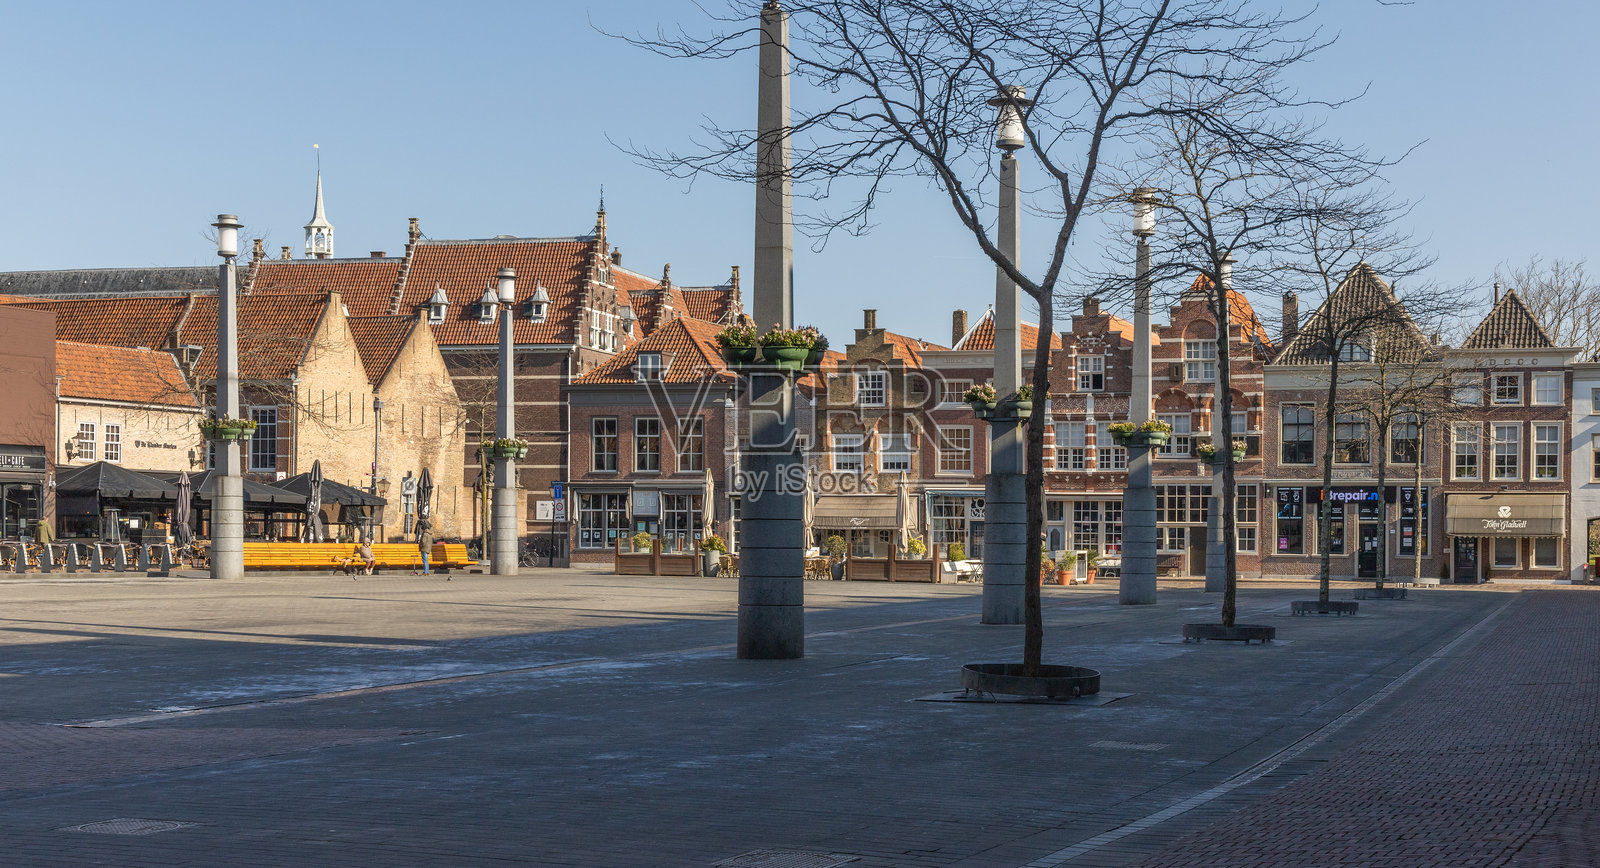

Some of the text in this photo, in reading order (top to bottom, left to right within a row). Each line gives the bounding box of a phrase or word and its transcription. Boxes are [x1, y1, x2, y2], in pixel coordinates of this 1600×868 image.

[11, 455, 24, 466] CAFE
[1481, 519, 1527, 530] John Gladwell
